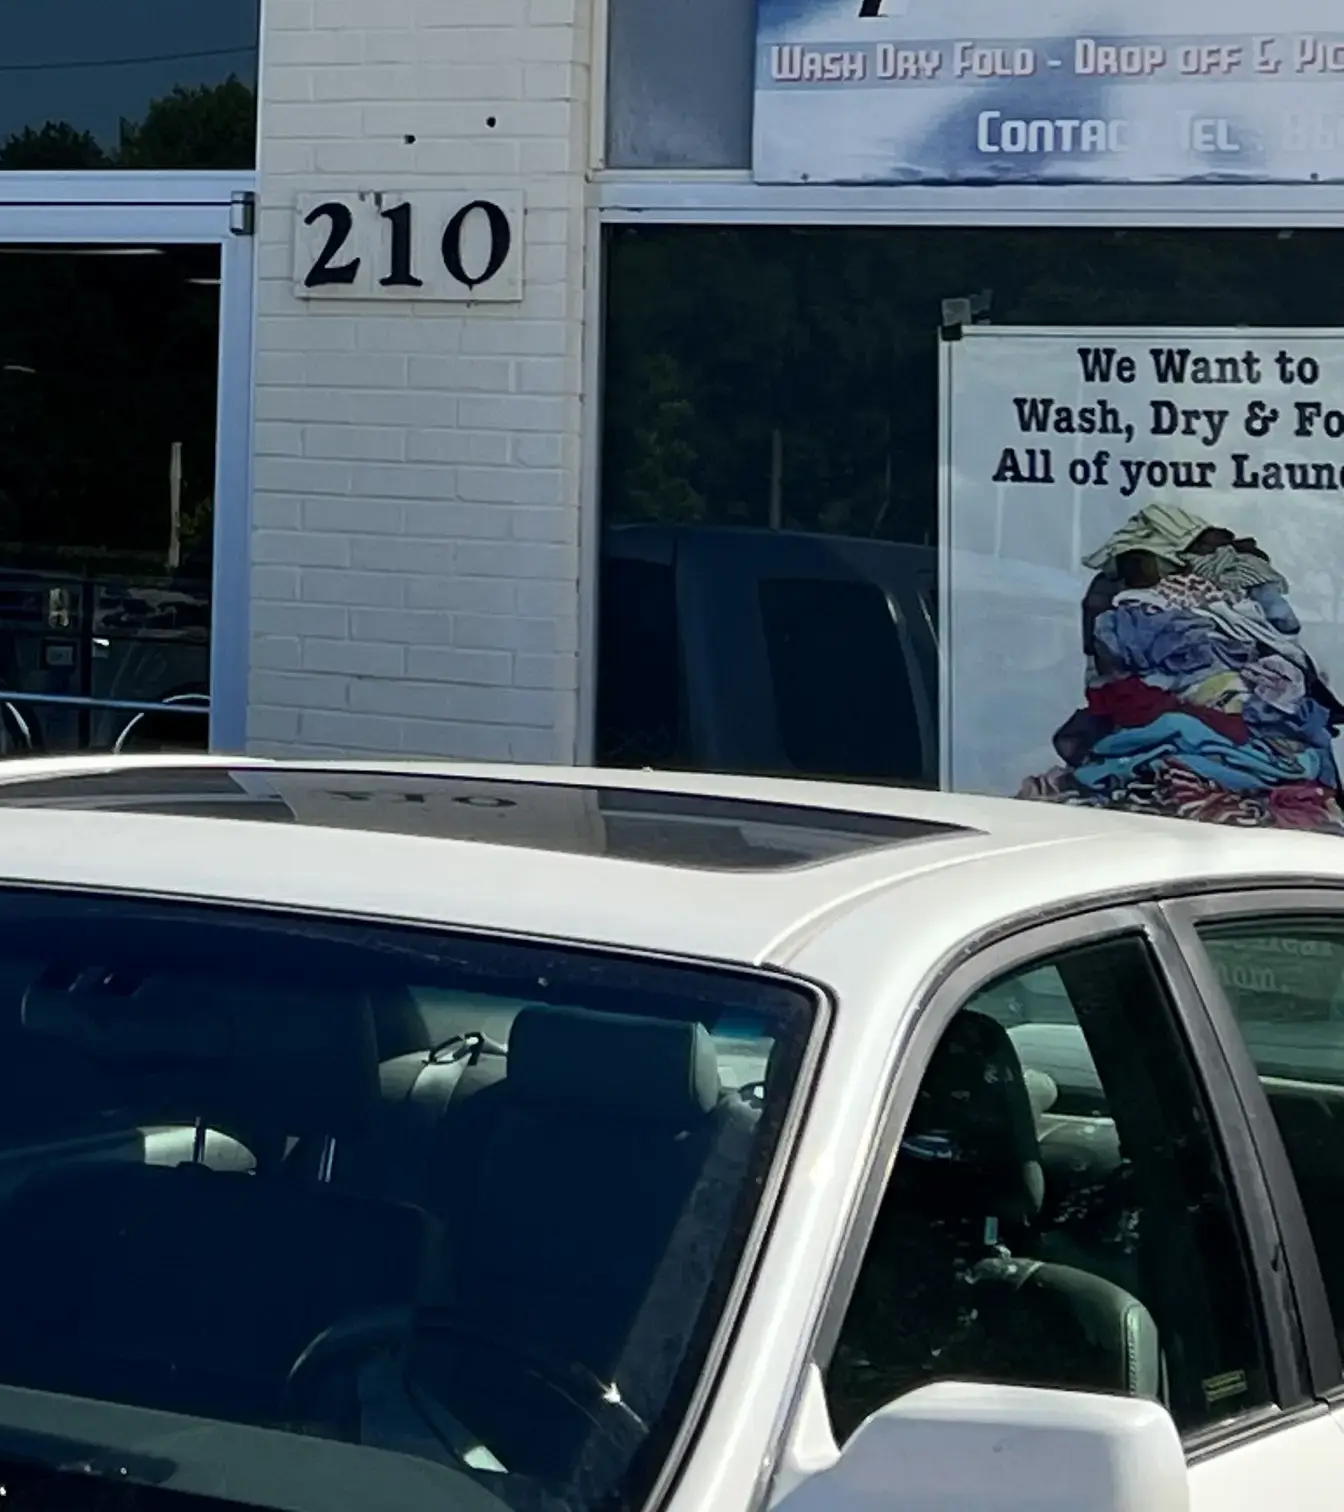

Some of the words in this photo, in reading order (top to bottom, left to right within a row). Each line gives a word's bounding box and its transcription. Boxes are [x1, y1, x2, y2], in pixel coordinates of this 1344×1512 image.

[977, 110, 1148, 154] CONTAC
[303, 199, 511, 288] 210
[1077, 347, 1137, 384] We
[1149, 348, 1262, 385] Want
[1274, 349, 1321, 385] to
[1012, 397, 1136, 443] Wash,
[1149, 399, 1230, 446] Dry
[1243, 400, 1280, 438] &
[991, 447, 1056, 484] All
[1068, 450, 1111, 486] of
[1118, 460, 1217, 497] your
[1230, 452, 1344, 490] Laun
